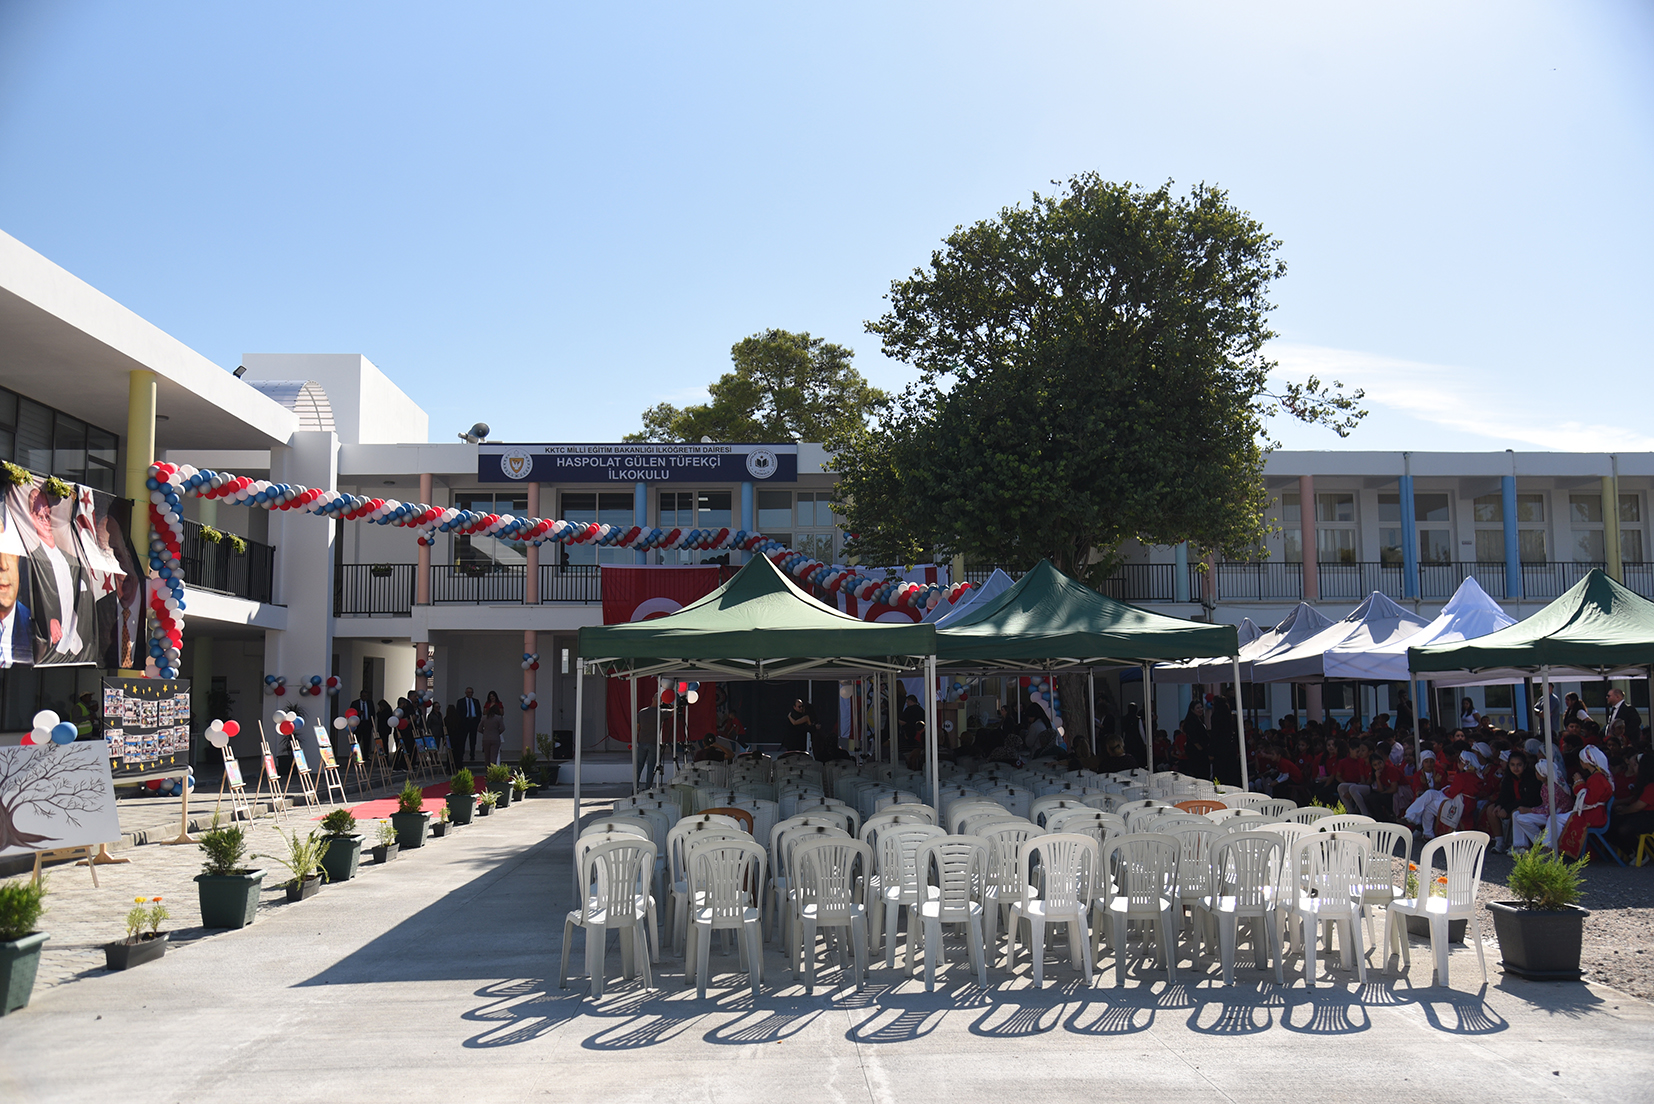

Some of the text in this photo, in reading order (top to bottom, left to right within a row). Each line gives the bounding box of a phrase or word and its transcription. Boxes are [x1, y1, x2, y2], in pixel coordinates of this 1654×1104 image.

[567, 445, 586, 453] MİLLİ
[588, 445, 612, 453] EĞİTİM
[614, 445, 654, 453] BAKANLIĞI
[656, 445, 701, 453] İLKÖĞRETİM
[703, 445, 732, 453] DAİRESİ
[557, 455, 720, 469] HASPOLAT GÜLEN TÜFEKÇİ
[608, 468, 670, 480] İLKOKULU
